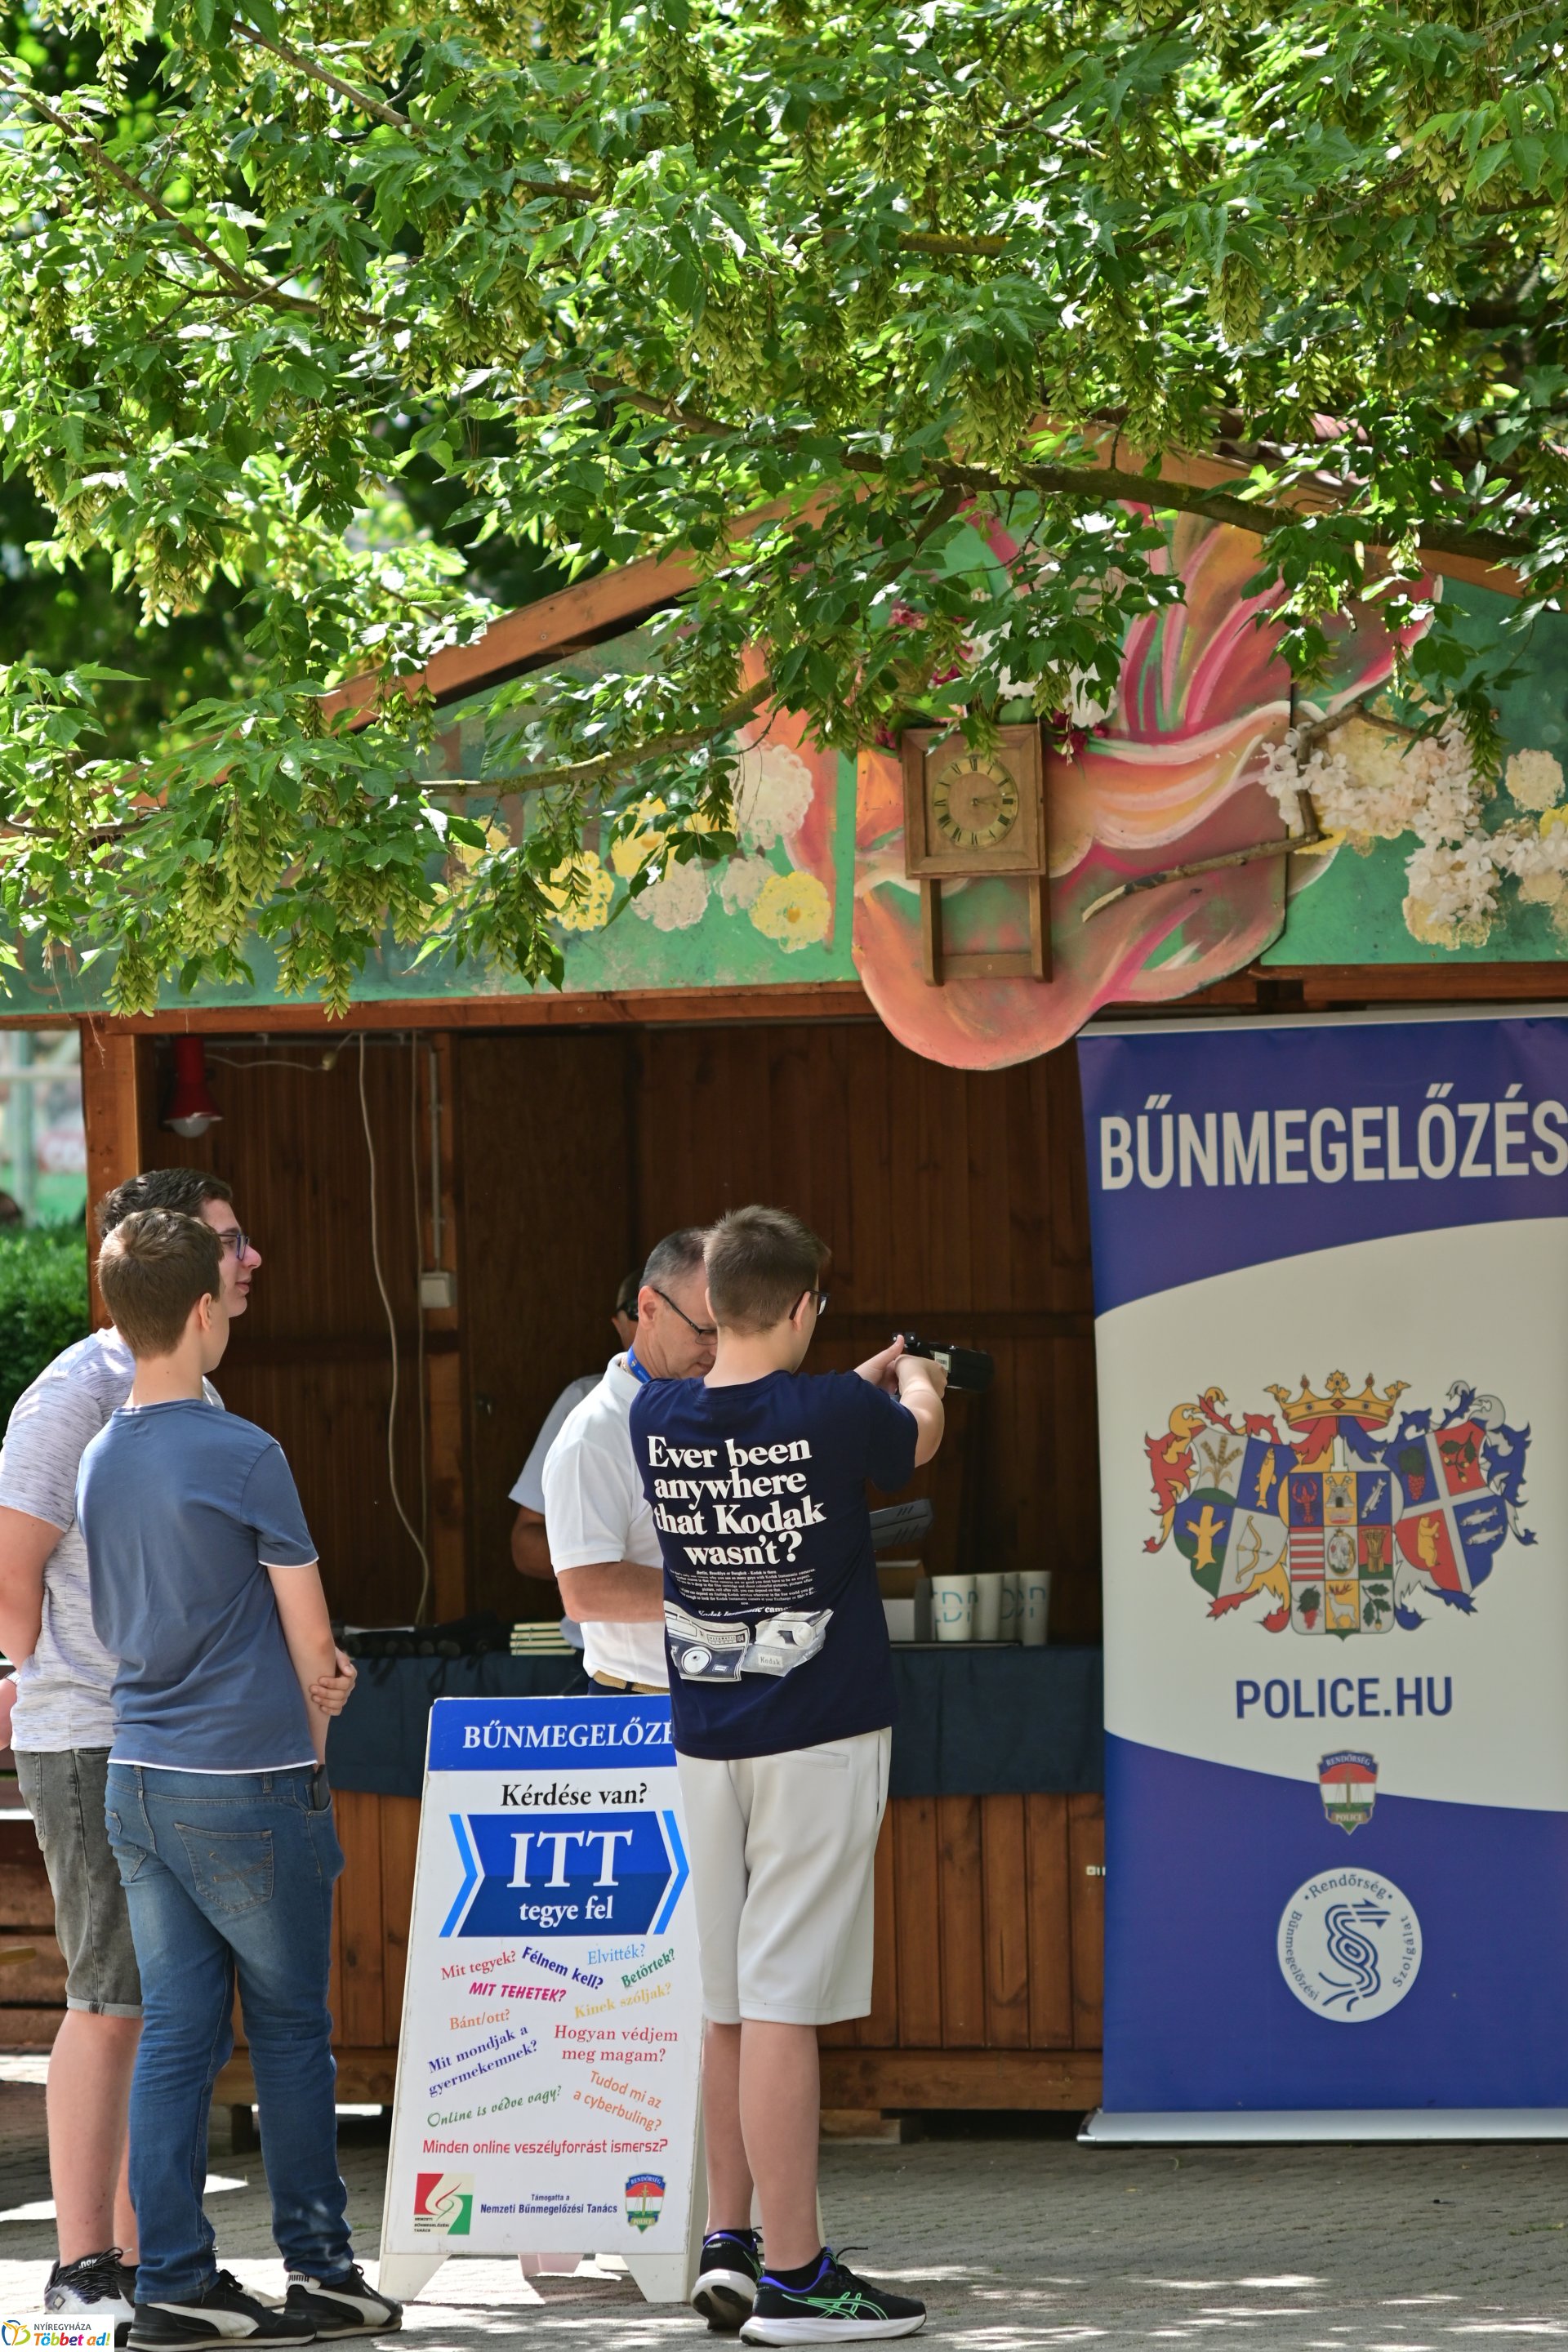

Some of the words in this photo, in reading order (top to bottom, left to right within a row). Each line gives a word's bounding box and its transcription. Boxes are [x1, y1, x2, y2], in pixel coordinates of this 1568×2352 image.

[1100, 1082, 1568, 1191] BŰNMEGELŐZÉS
[647, 1435, 718, 1468] Ever
[724, 1438, 812, 1468] been
[654, 1467, 807, 1510] anywhere
[653, 1503, 708, 1535] that
[713, 1494, 827, 1535] Kodak
[683, 1530, 803, 1566] wasn't?
[1236, 1677, 1453, 1719] POLICE.HU
[462, 1717, 672, 1748] BŰNMEGELŐZÉ
[1325, 1753, 1371, 1767] RENDŐRSÉG
[501, 1783, 592, 1806] Kérdése
[598, 1783, 648, 1805] van?
[506, 1829, 633, 1888] ITT
[1308, 1873, 1387, 1900] Rendőrség
[519, 1902, 578, 1929] tegye
[585, 1895, 613, 1920] fel
[440, 1964, 466, 1980] Mit
[470, 1950, 516, 1976] tegyek?
[521, 1946, 568, 1976] Félnem
[571, 1967, 604, 1990] kell?
[587, 1943, 646, 1966] Elvitték?
[620, 1948, 675, 1989] Betörtek?
[1285, 1910, 1320, 2001] Bűnmegelőzési
[1392, 1915, 1417, 1987] Szolgálat
[469, 1981, 497, 1997] MIT
[500, 1984, 567, 2002] TEHETEK?
[573, 1998, 616, 2020] Kinek
[619, 1982, 671, 2007] szóljak?
[449, 2008, 510, 2030] Bánt/ott?
[554, 2025, 616, 2042] Hogyan
[621, 2027, 679, 2042] védjem
[427, 2056, 452, 2074] Mit
[457, 2029, 516, 2063] mondjak
[519, 2026, 528, 2036] a
[561, 2050, 596, 2063] meg
[599, 2048, 666, 2065] magam?
[428, 2039, 537, 2098] gyermekemnek?
[426, 2109, 473, 2127] Online
[476, 2105, 487, 2117] is
[491, 2096, 523, 2112] védve
[528, 2085, 562, 2105] vagy?
[590, 2070, 629, 2096] Tudod
[629, 2089, 647, 2103] mi
[647, 2096, 662, 2109] az
[573, 2090, 581, 2100] a
[584, 2095, 662, 2132] cyberbuling?
[422, 2140, 469, 2154] Minden
[473, 2140, 510, 2154] online
[514, 2139, 607, 2156] veszélyforrást
[611, 2138, 668, 2154] ismersz?
[480, 2203, 516, 2214] Nemzeti
[519, 2203, 584, 2215] Bűnmegelőzési
[586, 2203, 618, 2214] Tanács
[531, 2194, 564, 2202] Támogatta
